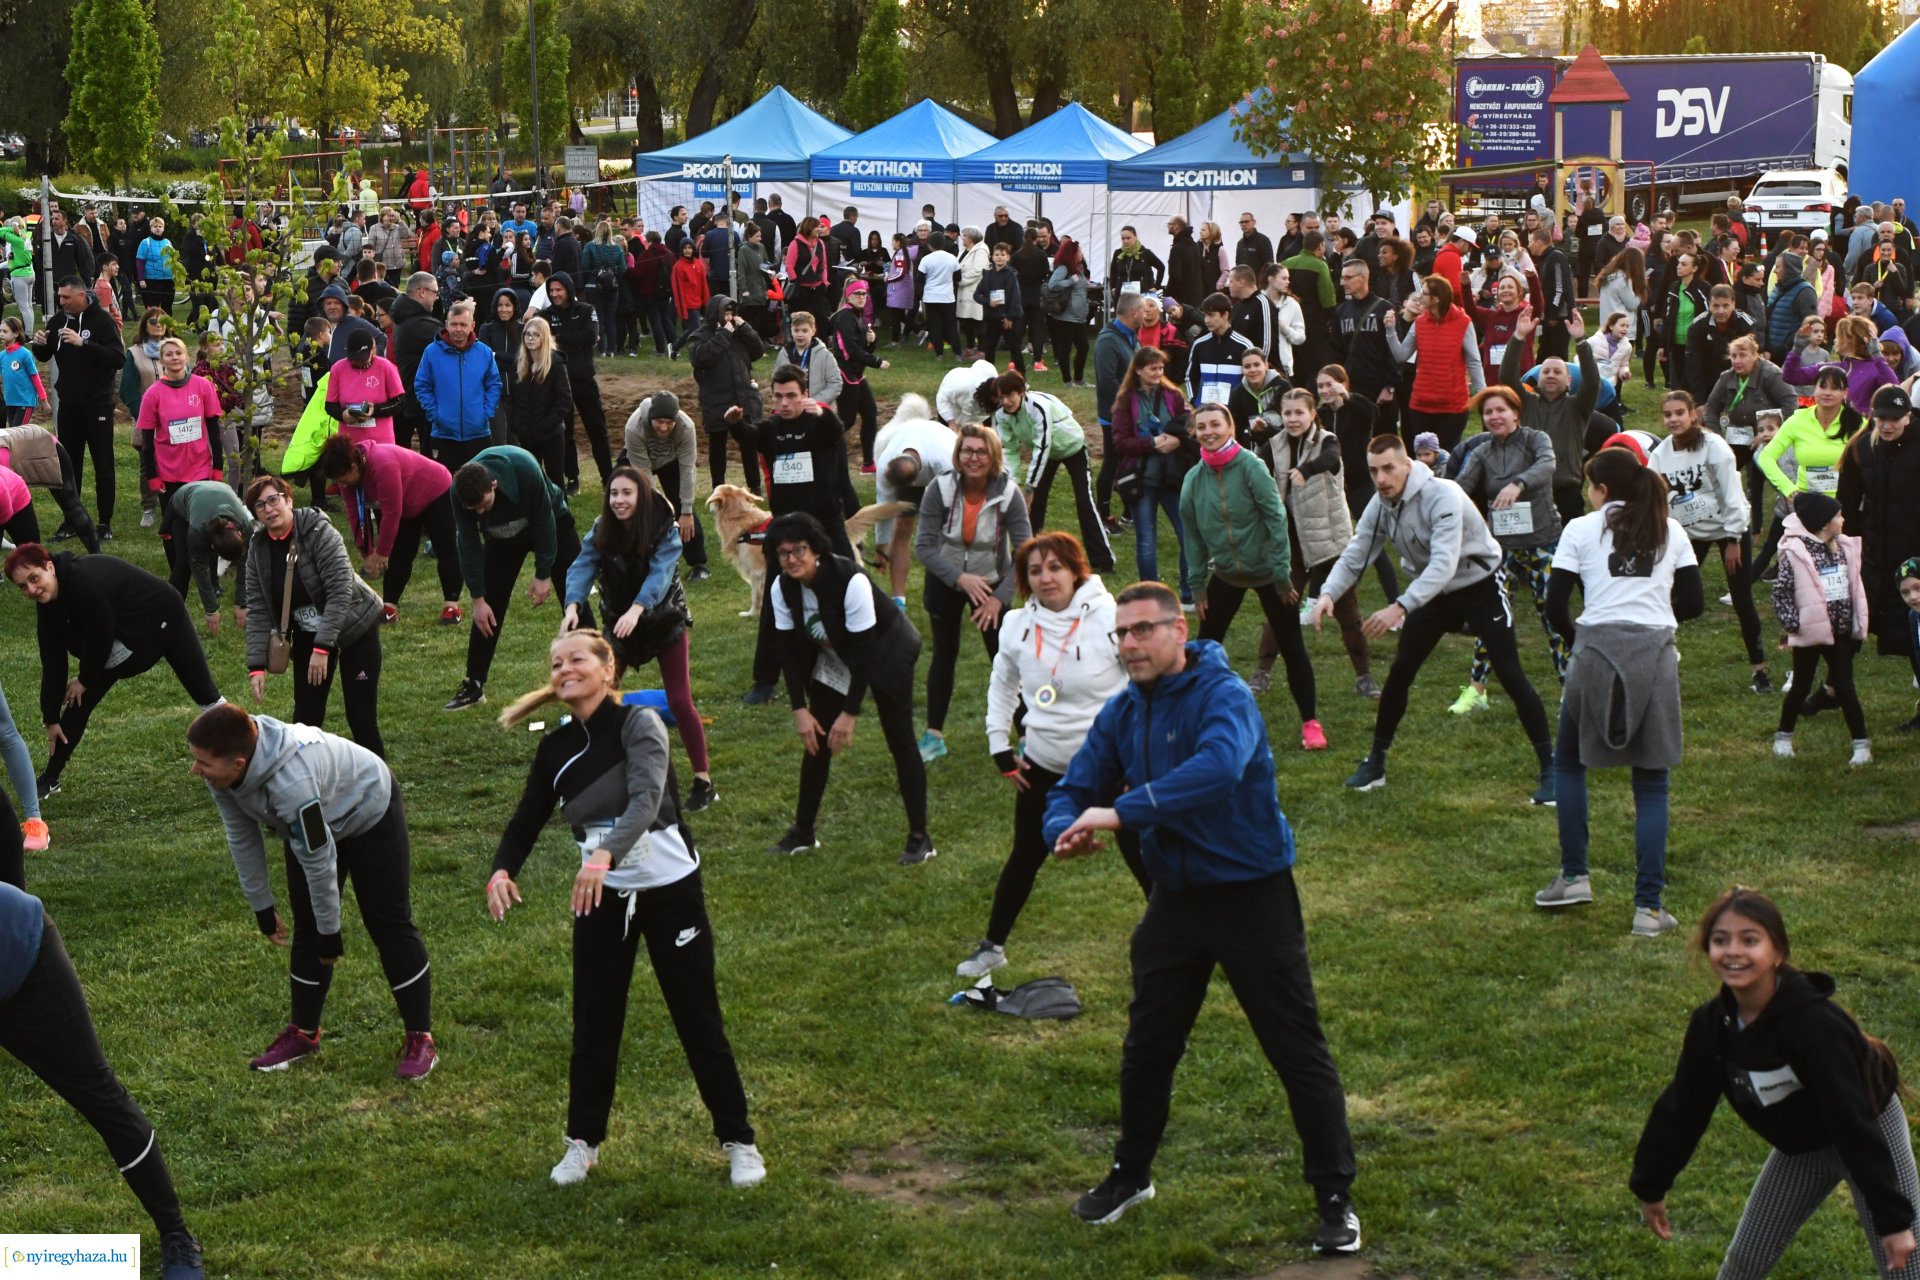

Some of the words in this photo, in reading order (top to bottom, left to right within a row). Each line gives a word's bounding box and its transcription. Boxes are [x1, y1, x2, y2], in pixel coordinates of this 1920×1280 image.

[1511, 83, 1535, 91] TRANS
[1656, 86, 1730, 138] DSV
[839, 160, 923, 178] DECATHLON
[994, 163, 1062, 175] DECATHLON
[1164, 169, 1257, 187] DECATHLON
[697, 183, 722, 192] ONLINE
[178, 425, 193, 433] 1412
[781, 462, 803, 471] 1340
[1500, 512, 1520, 522] 1278
[299, 608, 318, 620] 150
